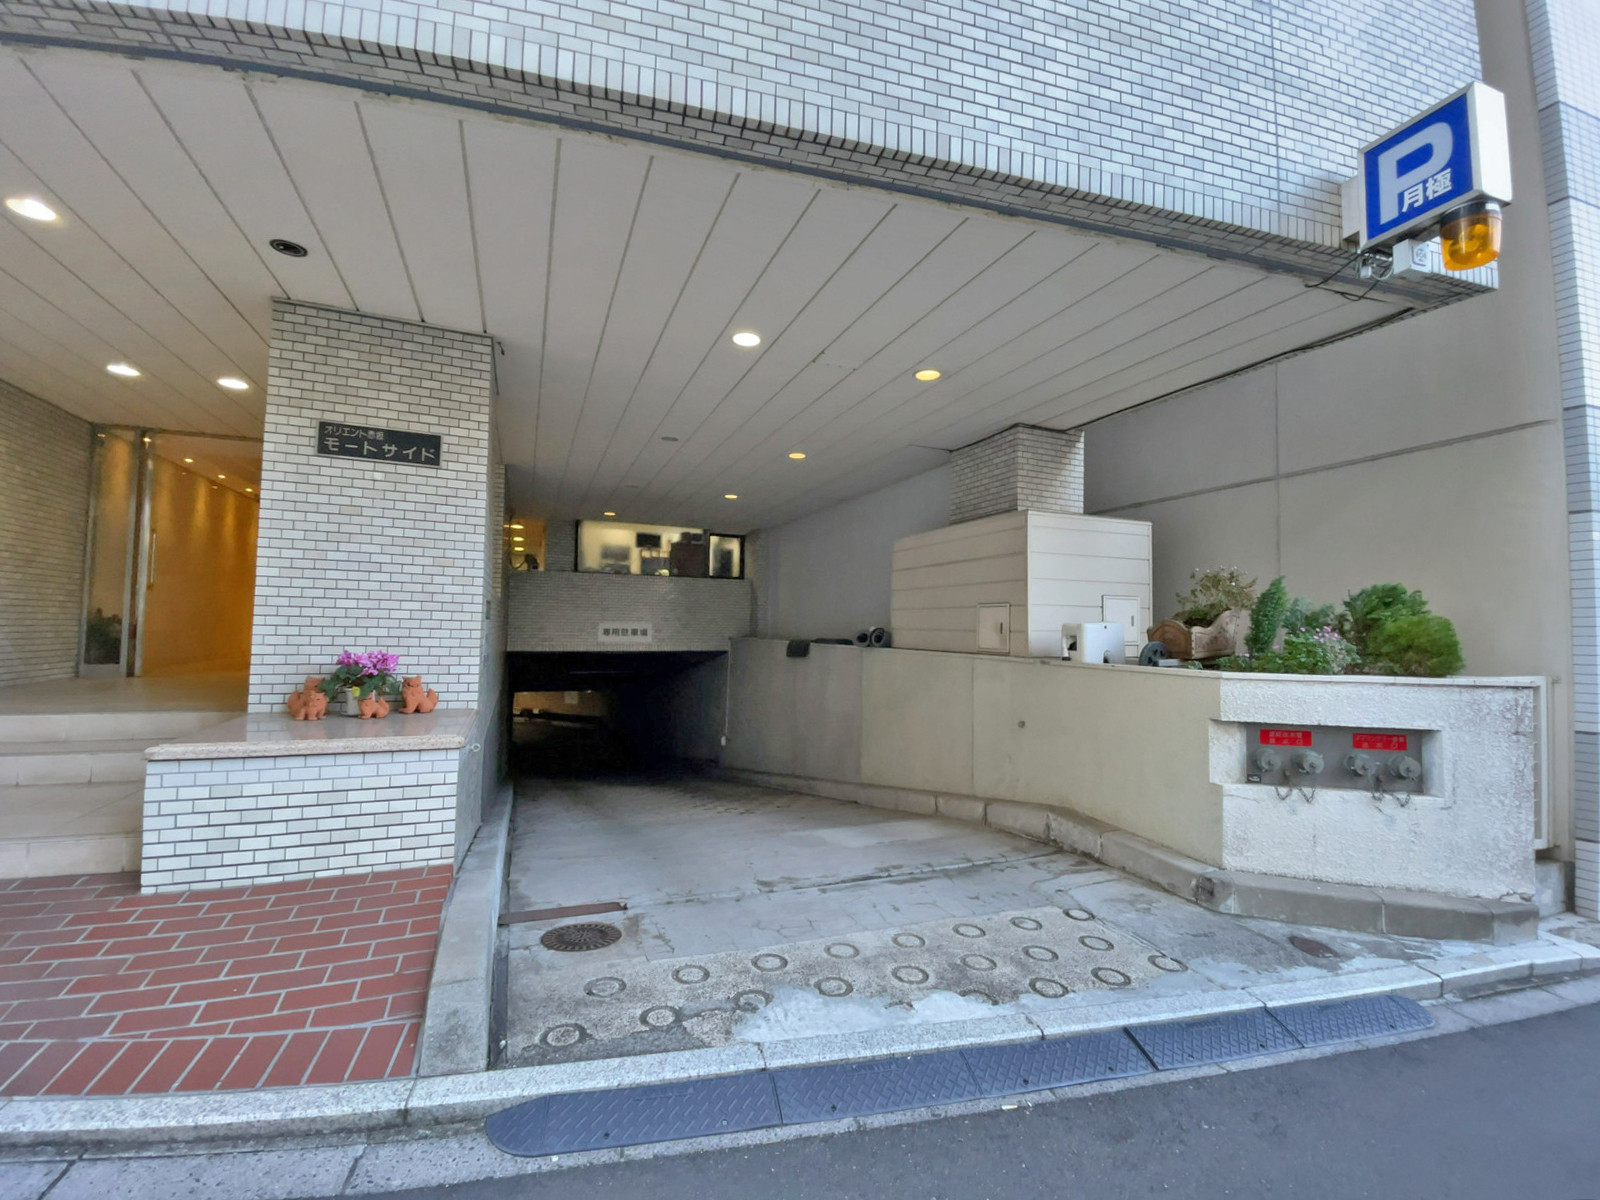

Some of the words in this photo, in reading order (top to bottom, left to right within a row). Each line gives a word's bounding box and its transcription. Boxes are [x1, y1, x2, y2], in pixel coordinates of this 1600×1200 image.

[1378, 121, 1453, 225] P
[1402, 168, 1452, 213] 月極
[324, 437, 435, 461] モートサイド
